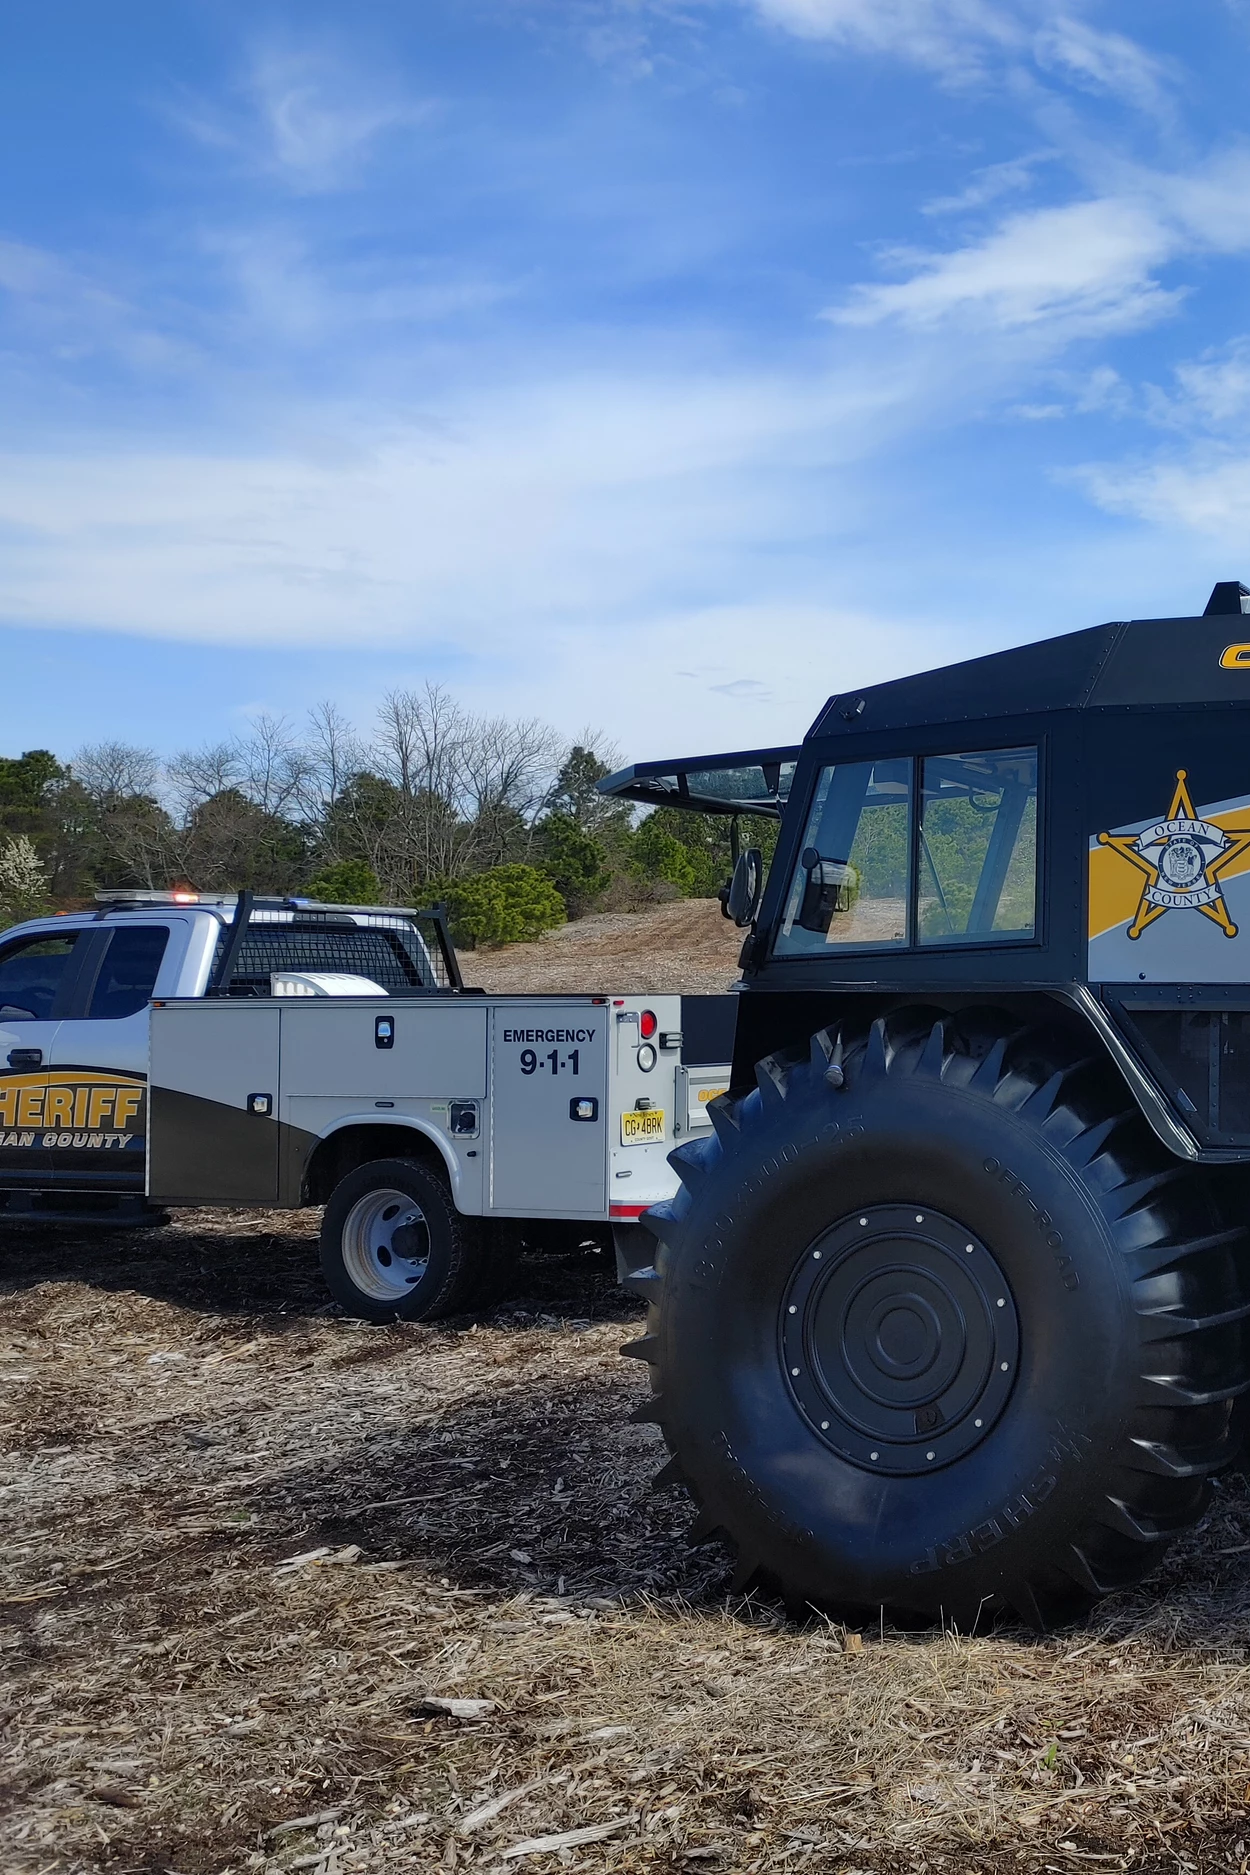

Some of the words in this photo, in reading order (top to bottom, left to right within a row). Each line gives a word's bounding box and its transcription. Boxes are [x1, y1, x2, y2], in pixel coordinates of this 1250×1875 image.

[1154, 821, 1210, 837] OCEAN
[1152, 888, 1211, 906] COUNTY
[503, 1029, 596, 1043] EMERGENCY
[42, 1132, 134, 1148] COUNTY
[982, 1156, 1081, 1292] OFF-ROAD
